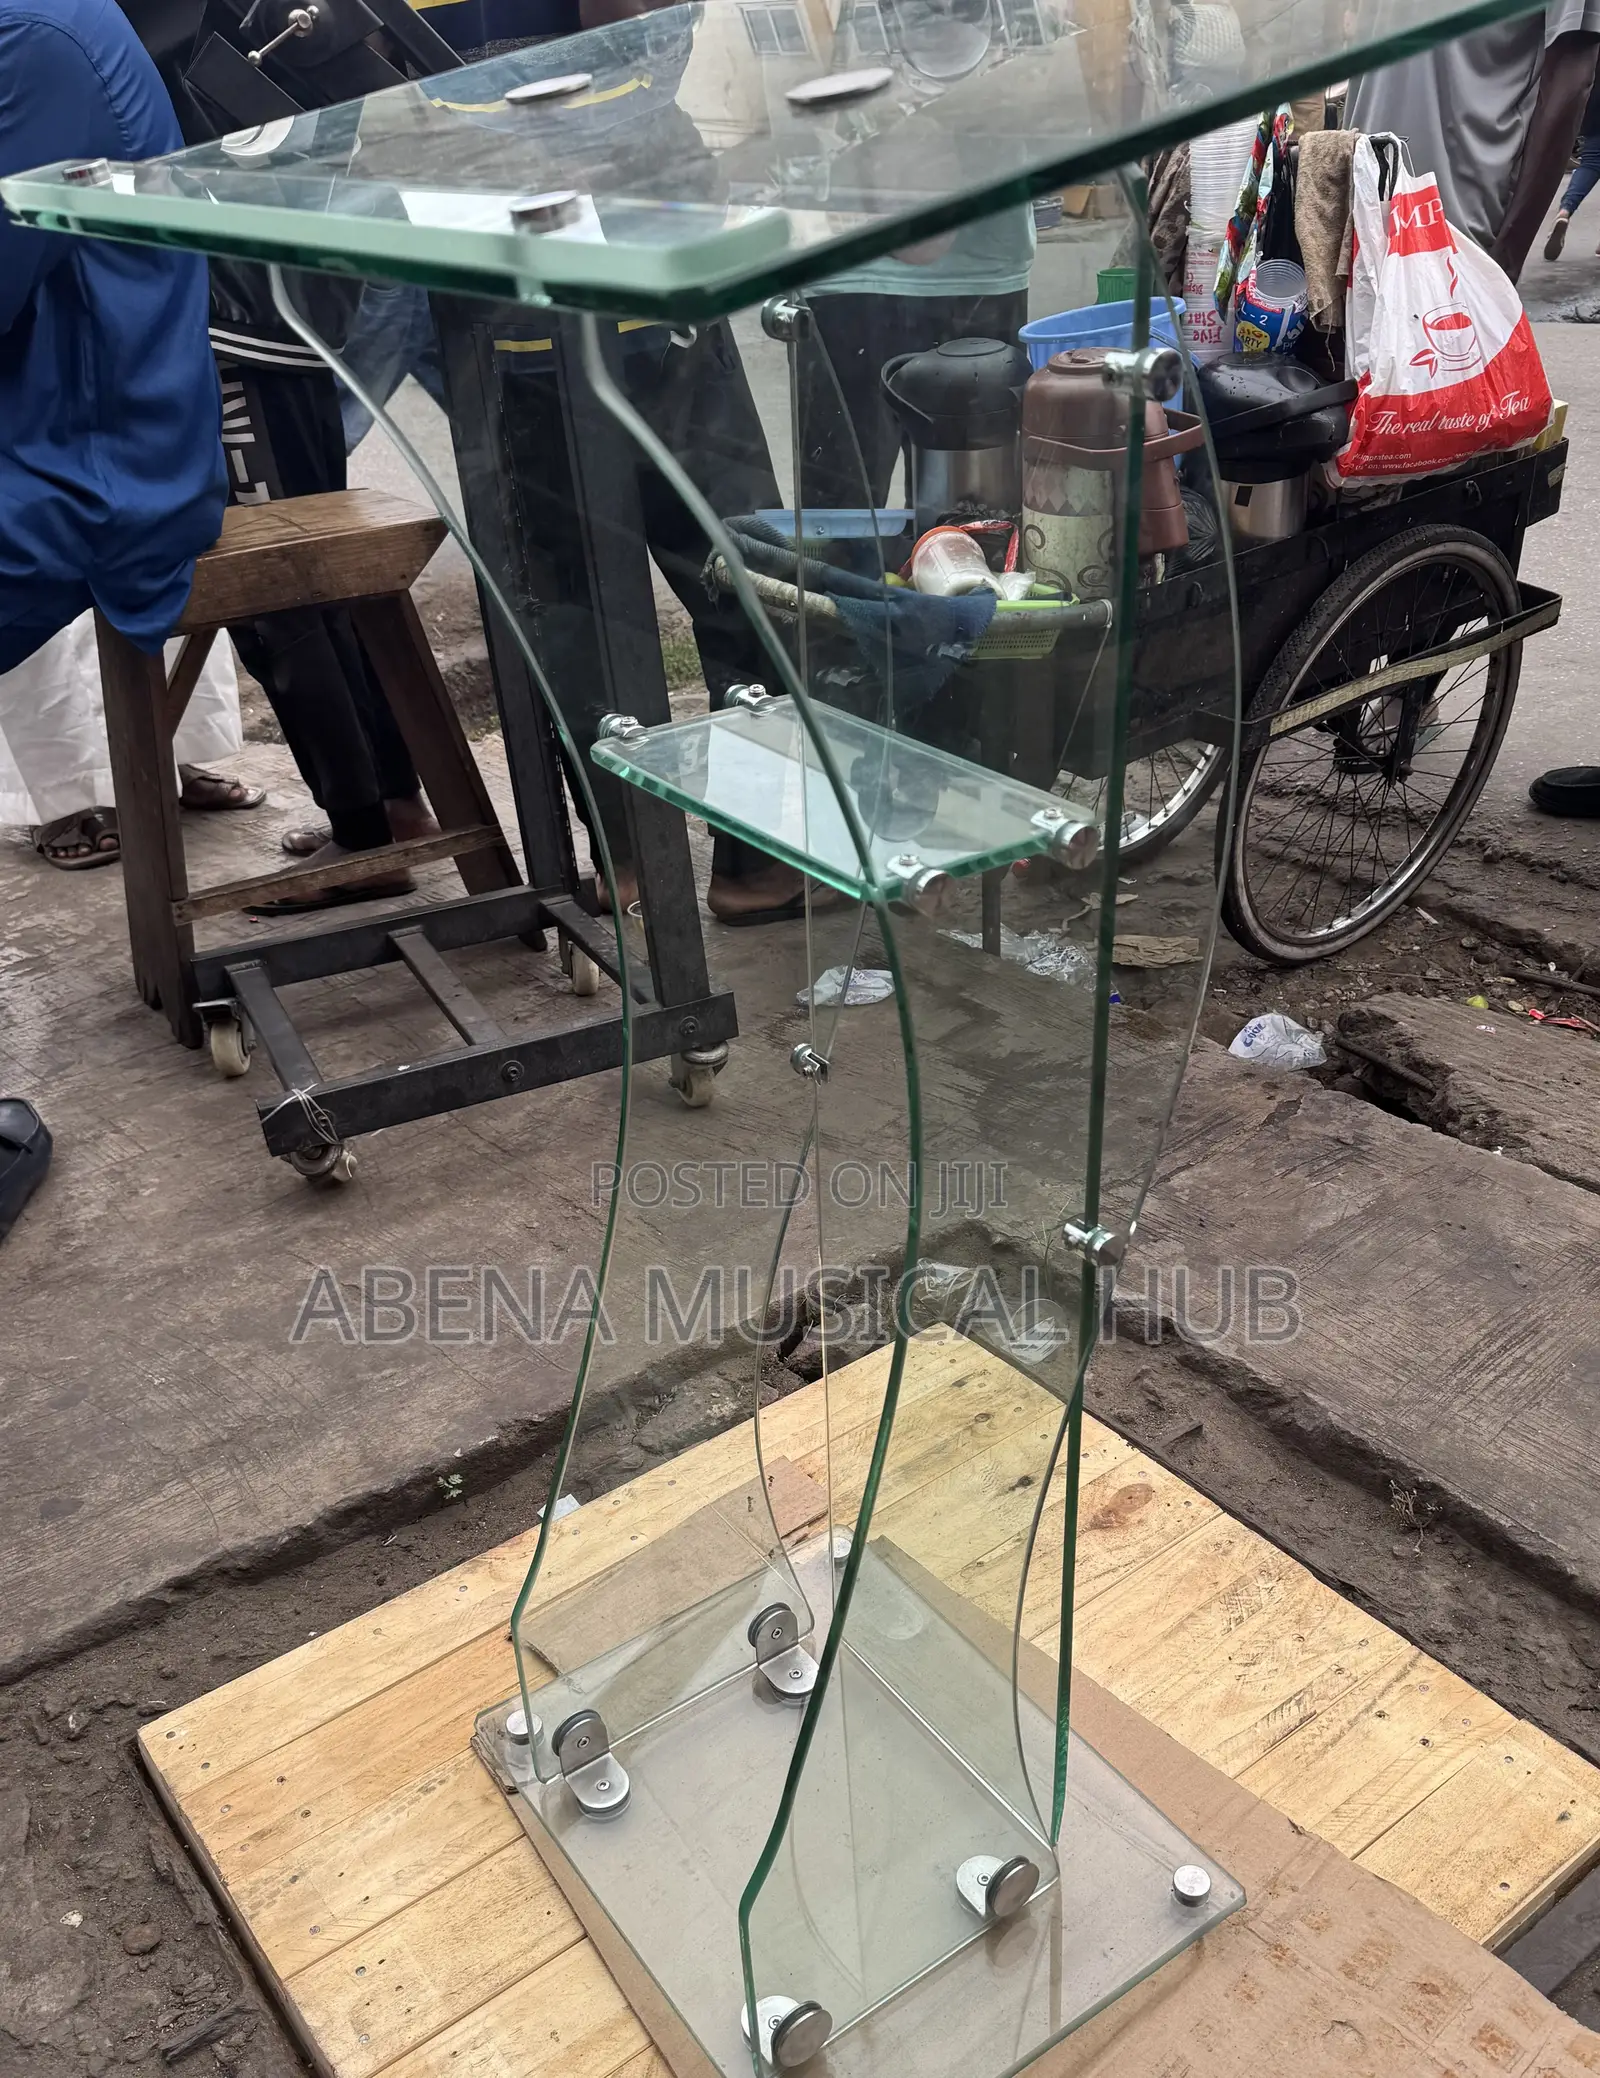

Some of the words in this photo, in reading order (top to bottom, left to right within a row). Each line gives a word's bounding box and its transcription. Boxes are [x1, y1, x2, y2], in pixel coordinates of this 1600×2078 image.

[1187, 309, 1216, 327] Star
[1193, 326, 1222, 344] Five
[1365, 410, 1403, 435] The
[1402, 411, 1440, 435] real
[1438, 414, 1475, 431] taste
[1475, 405, 1496, 433] of
[1499, 390, 1530, 420] Tea
